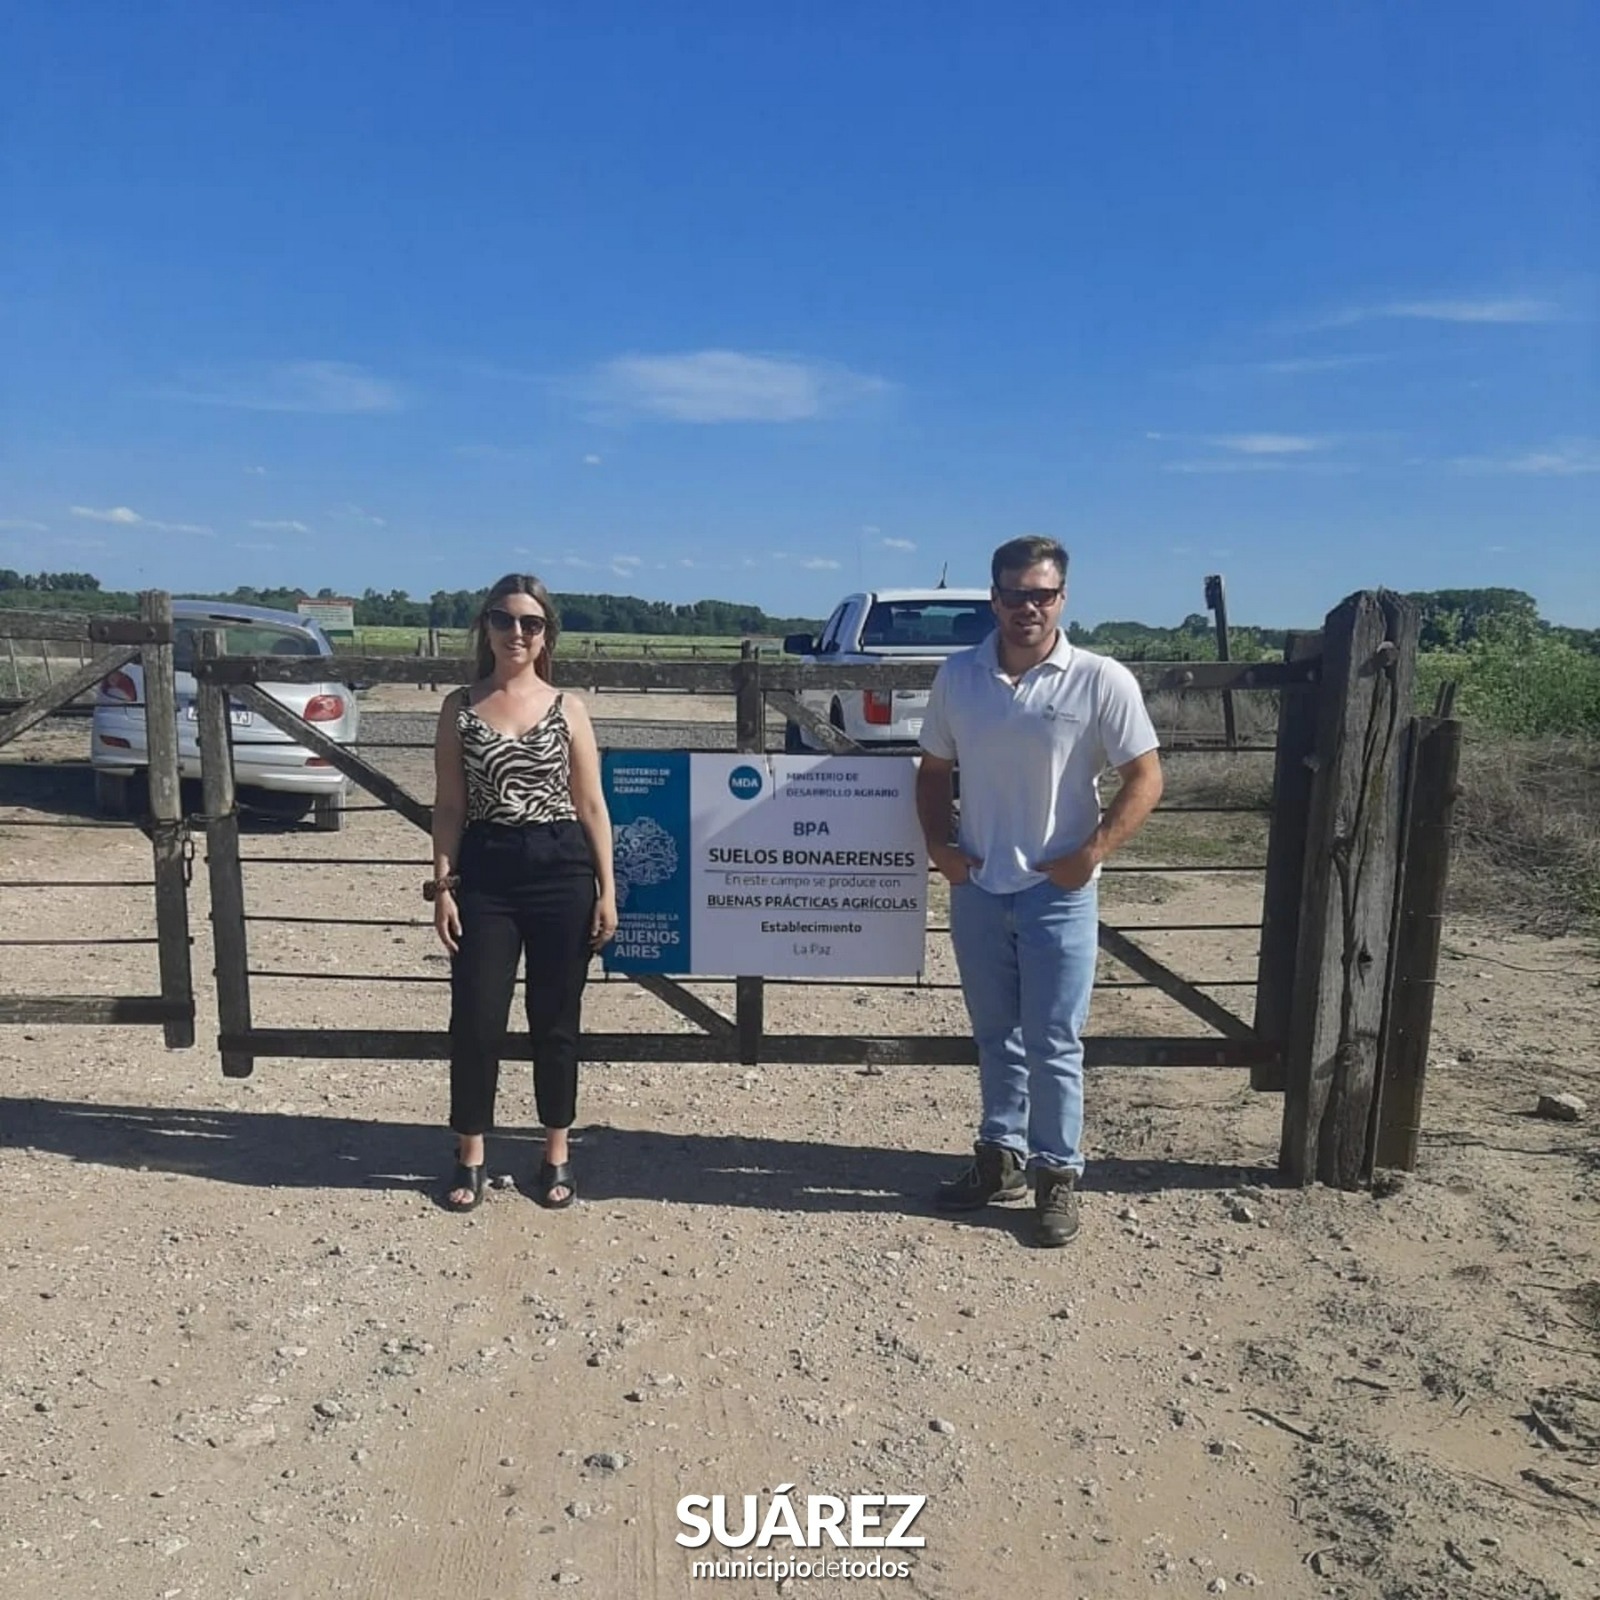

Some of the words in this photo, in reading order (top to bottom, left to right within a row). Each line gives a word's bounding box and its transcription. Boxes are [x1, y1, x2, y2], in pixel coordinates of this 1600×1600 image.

[731, 777, 760, 789] MDA
[787, 772, 844, 783] MINISTERIO
[846, 772, 859, 783] DE
[786, 788, 852, 798] DESARROLLO
[853, 789, 899, 799] AGRARIO
[792, 821, 830, 837] BPA
[708, 847, 778, 865] SUELOS
[782, 850, 915, 867] BONAERENSES
[725, 874, 741, 886] En
[743, 876, 770, 886] este
[771, 877, 811, 889] campo
[812, 878, 826, 888] se
[828, 876, 876, 889] produce
[879, 878, 901, 889] con
[707, 894, 762, 908] BUENAS
[764, 893, 839, 909] PRÁCTICAS
[842, 894, 918, 910] AGRÍCOLAS
[760, 920, 863, 934] Establecimiento
[614, 929, 680, 945] BUENOS
[614, 944, 661, 959] AIRES
[793, 943, 808, 956] La
[810, 943, 832, 956] Paz
